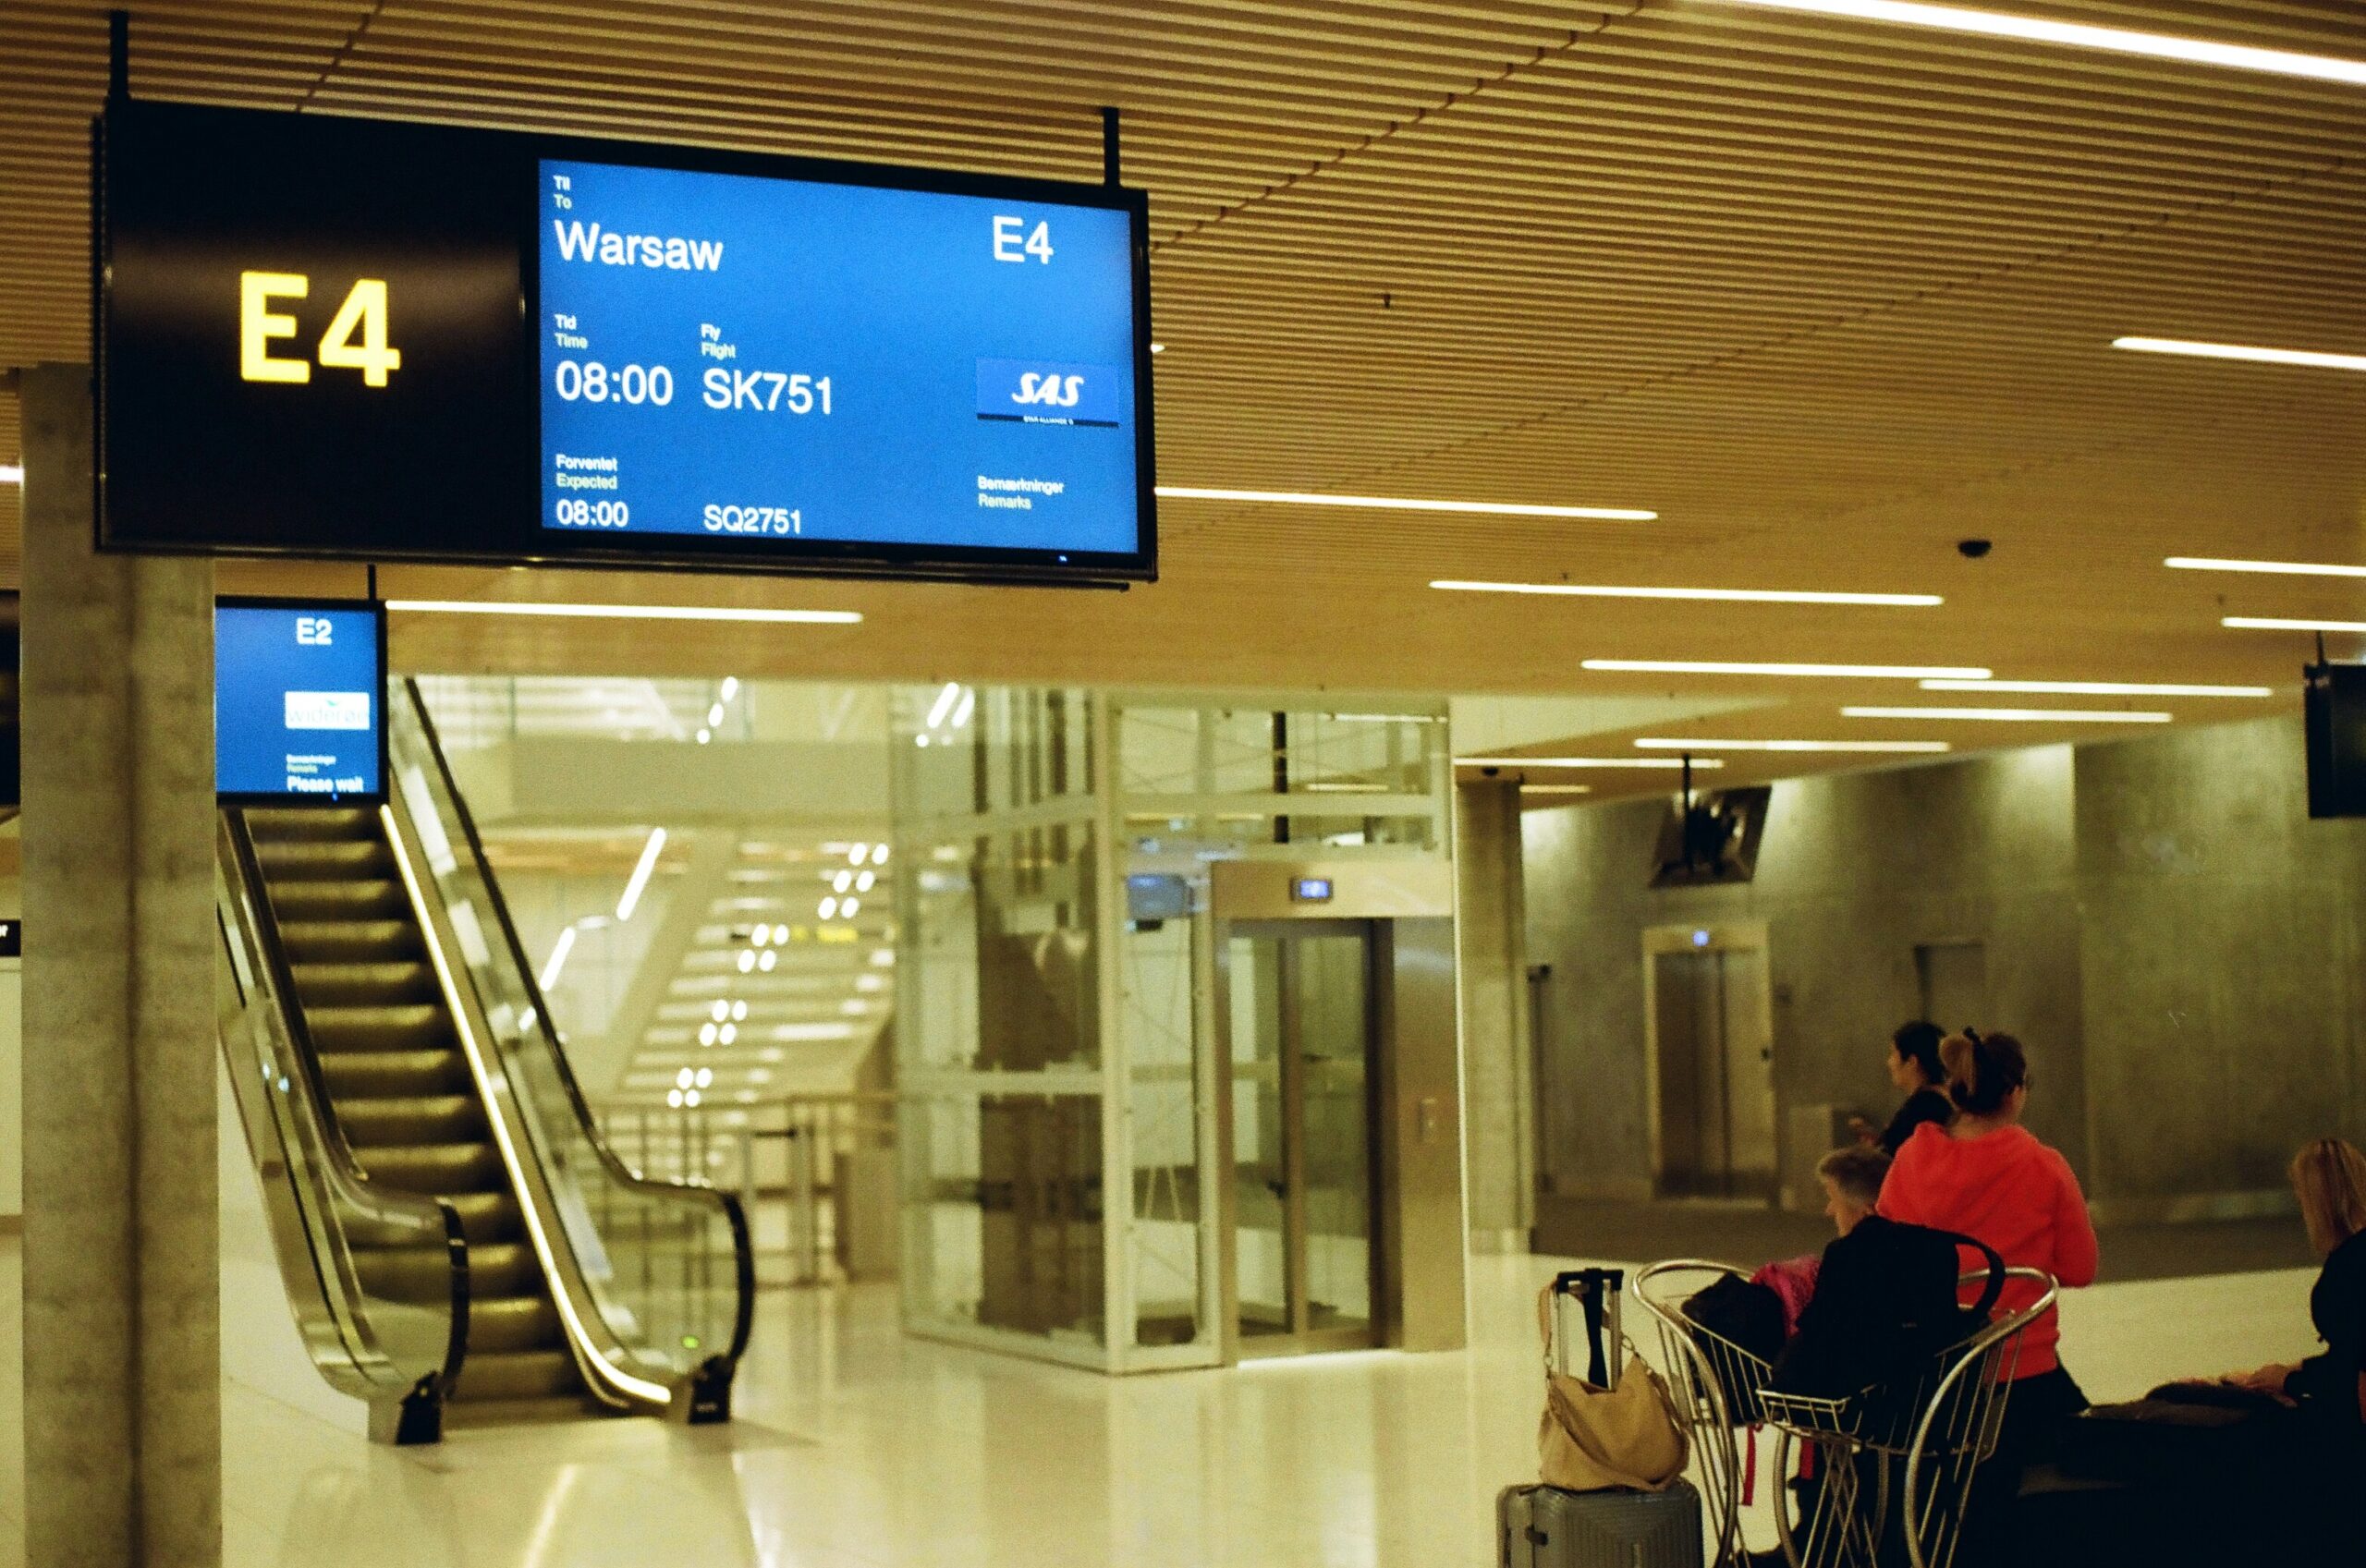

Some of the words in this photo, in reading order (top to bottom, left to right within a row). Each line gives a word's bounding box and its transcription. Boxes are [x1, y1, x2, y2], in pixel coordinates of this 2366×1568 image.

[553, 175, 571, 191] Til
[553, 193, 573, 210] To
[554, 219, 724, 272] Warsaw
[993, 215, 1055, 264] E4
[239, 270, 401, 387] E4
[554, 313, 578, 330] Tid
[701, 323, 721, 341] Fly
[554, 332, 589, 349] Time
[701, 341, 737, 360] Flight
[555, 359, 674, 406] 08:00
[702, 367, 831, 415] SK751
[1011, 372, 1084, 407] SAS
[555, 454, 618, 472] Forventet
[555, 472, 618, 491] Expected
[556, 498, 629, 528] 08:00
[979, 492, 1032, 510] Remarks
[703, 504, 800, 535] SQ2751
[296, 616, 333, 645] E2
